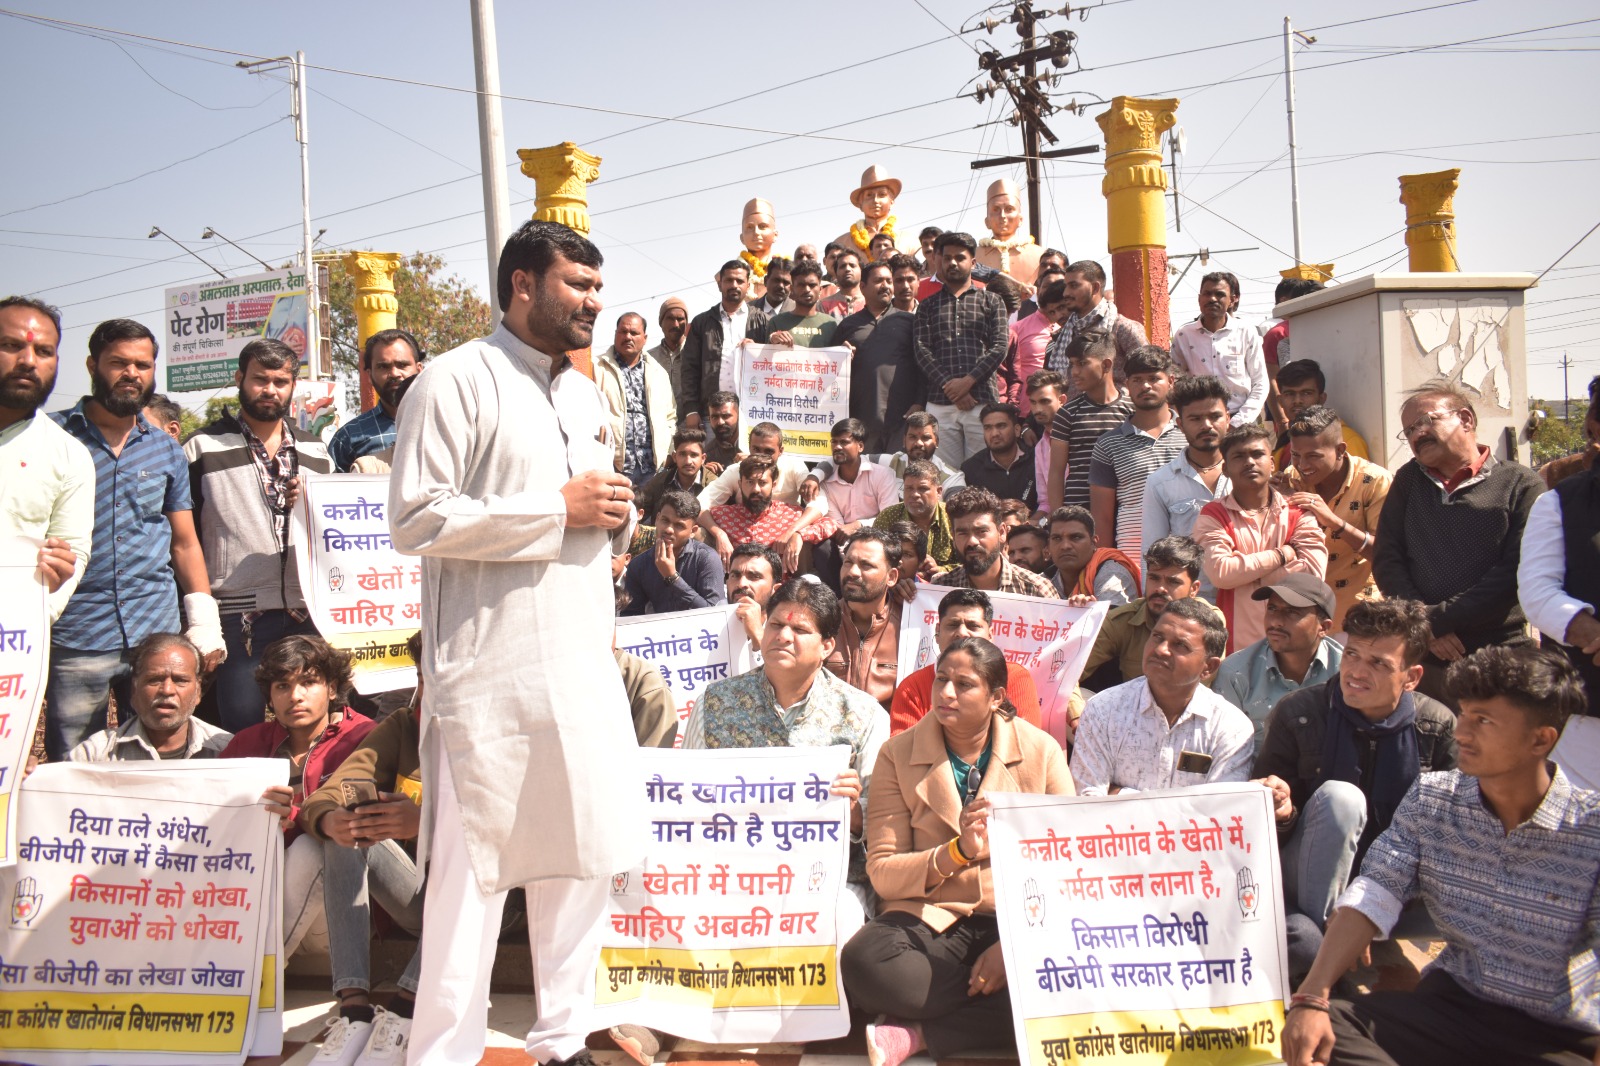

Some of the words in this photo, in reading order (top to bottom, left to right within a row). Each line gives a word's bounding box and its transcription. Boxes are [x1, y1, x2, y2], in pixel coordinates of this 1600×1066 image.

[199, 284, 240, 301] अमलतास
[242, 278, 284, 295] अस्पताल,
[287, 270, 306, 290] देवा
[170, 310, 192, 337] पेट
[196, 306, 225, 334] रोग
[173, 341, 181, 352] की
[183, 340, 197, 354] संपूर्ण
[199, 338, 224, 350] चिकित्सा
[752, 358, 773, 373] कन्नौद
[775, 359, 803, 373] खातेगांव
[804, 360, 812, 373] के
[764, 374, 783, 389] नर्मदा
[785, 378, 798, 388] जल
[799, 378, 816, 390] लाना
[766, 393, 792, 407] किसान
[794, 394, 819, 409] विरोधी
[776, 411, 802, 423] सरकार
[804, 412, 827, 425] हटाना
[828, 411, 835, 426] है
[799, 436, 828, 448] विधानसभा
[322, 497, 384, 521] कन्नौद
[357, 565, 403, 591] खेतों
[329, 599, 394, 627] चाहिए
[1014, 616, 1029, 640] के
[355, 640, 387, 662] कांग्रेस
[698, 629, 719, 652] के
[678, 662, 728, 691] पुकार
[692, 775, 796, 804] खातेगांव
[804, 773, 830, 803] के
[69, 808, 113, 836] दिया
[118, 813, 151, 838] तले
[157, 816, 212, 847] अंधेरा,
[702, 813, 738, 843] की
[745, 813, 764, 848] है
[772, 820, 841, 851] पुकार
[1018, 828, 1072, 862] कन्नौद
[1076, 824, 1151, 859] खातेगांव
[1155, 821, 1176, 854] के
[1180, 818, 1223, 852] खेतो
[1228, 816, 1251, 854] में,
[19, 836, 86, 864] बीजेपी
[91, 846, 129, 866] राज
[132, 843, 152, 868] में
[154, 845, 198, 873] कैसा
[203, 847, 256, 874] सवेरा,
[69, 874, 153, 906] किसानों
[155, 882, 186, 909] को
[192, 882, 252, 911] धोखा,
[642, 864, 701, 896] खेतों
[708, 863, 730, 896] में
[736, 864, 795, 896] पानी
[1108, 873, 1144, 898] जल
[1149, 871, 1195, 898] लाना
[1198, 860, 1221, 899] है,
[69, 912, 143, 945] युवाओं
[146, 915, 177, 942] को
[183, 914, 244, 944] धोखा,
[611, 906, 685, 944] चाहिए
[694, 906, 773, 938] अबकी
[779, 911, 819, 935] बार
[1070, 917, 1140, 950] किसान
[1143, 912, 1209, 948] विरोधी
[33, 959, 100, 986] बीजेपी
[105, 968, 133, 986] का
[138, 962, 186, 986] लेखा
[191, 961, 245, 988] जोखा
[608, 966, 634, 992] युवा
[636, 959, 675, 987] कांग्रेस
[678, 962, 729, 988] खातेगांव
[731, 961, 794, 988] विधानसभा
[798, 963, 827, 986] 173
[1035, 954, 1105, 993] बीजेपी
[1108, 962, 1175, 988] सरकार
[1177, 959, 1236, 991] हटाना
[1240, 947, 1253, 987] है
[17, 1001, 63, 1030] कांग्रेस
[65, 1003, 126, 1031] खातेगांव
[127, 1003, 204, 1034] विधानसभा
[207, 1011, 235, 1034] 173
[1041, 1037, 1070, 1066] युवा
[1073, 1026, 1116, 1058] कांग्रेस
[1118, 1024, 1176, 1055] खातेगांव
[1178, 1022, 1249, 1052] विधानसभा
[1252, 1019, 1276, 1046] 173
